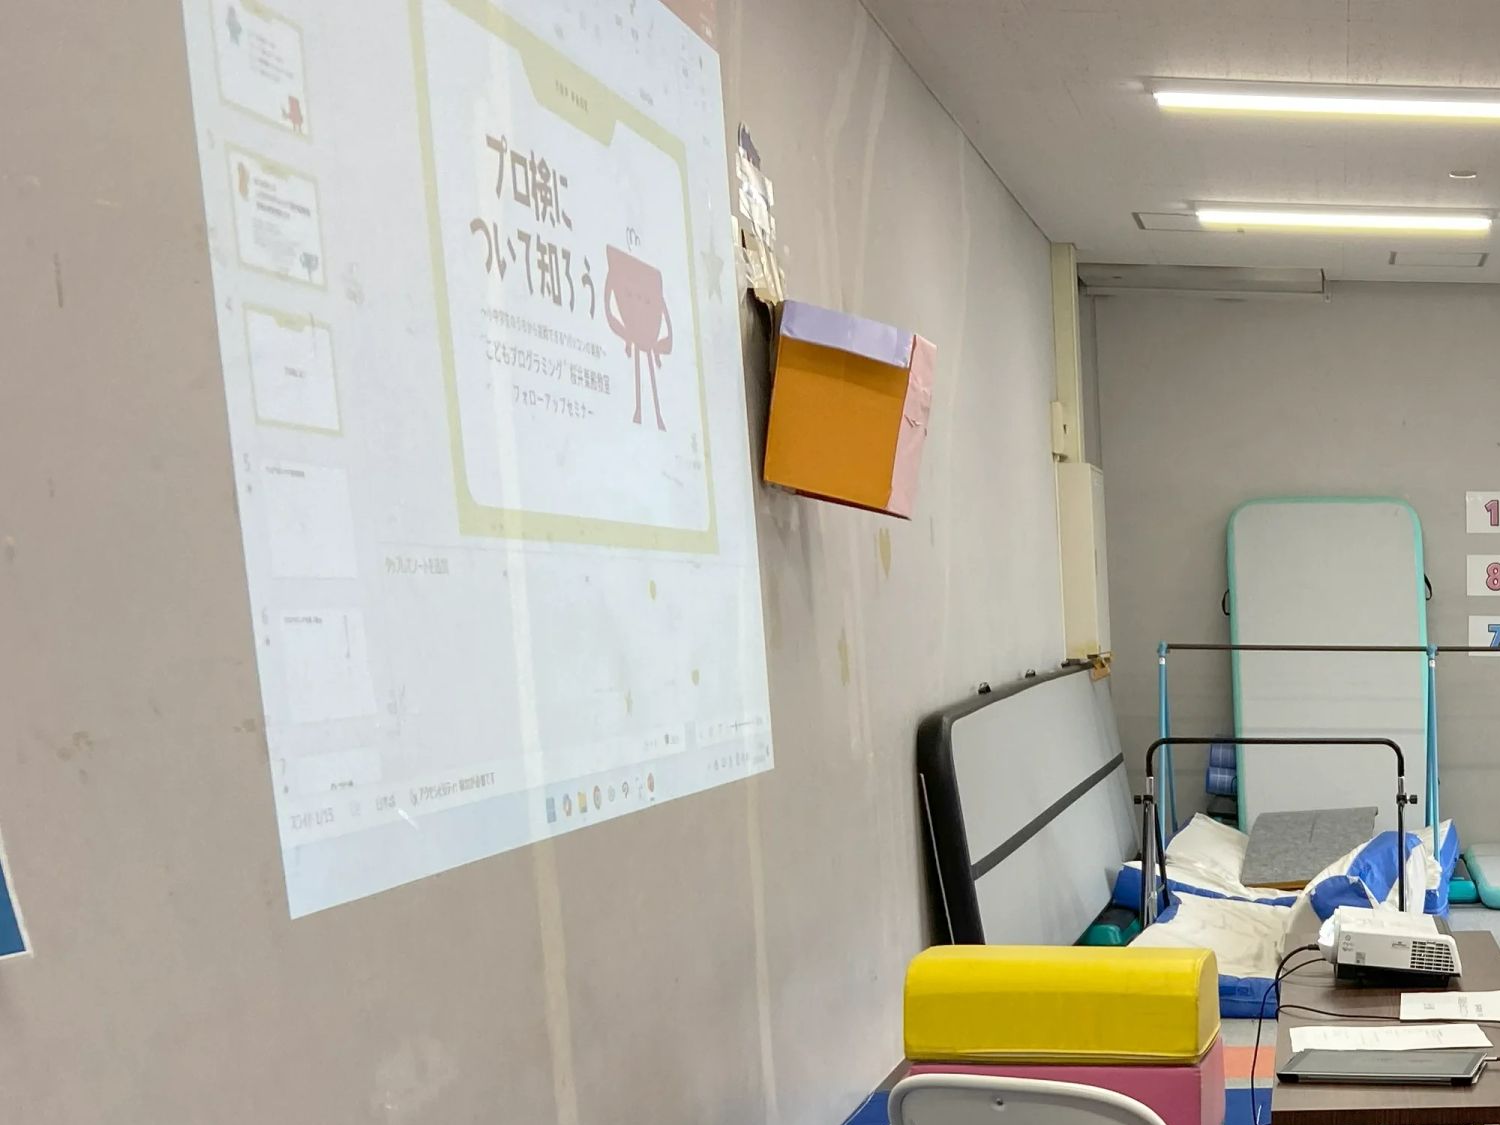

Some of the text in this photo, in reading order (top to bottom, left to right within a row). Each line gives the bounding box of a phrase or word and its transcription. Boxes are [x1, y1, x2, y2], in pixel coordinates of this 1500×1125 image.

[485, 133, 572, 231] プロ検に
[469, 217, 596, 320] ついて知ろう
[1484, 499, 1500, 526] 1
